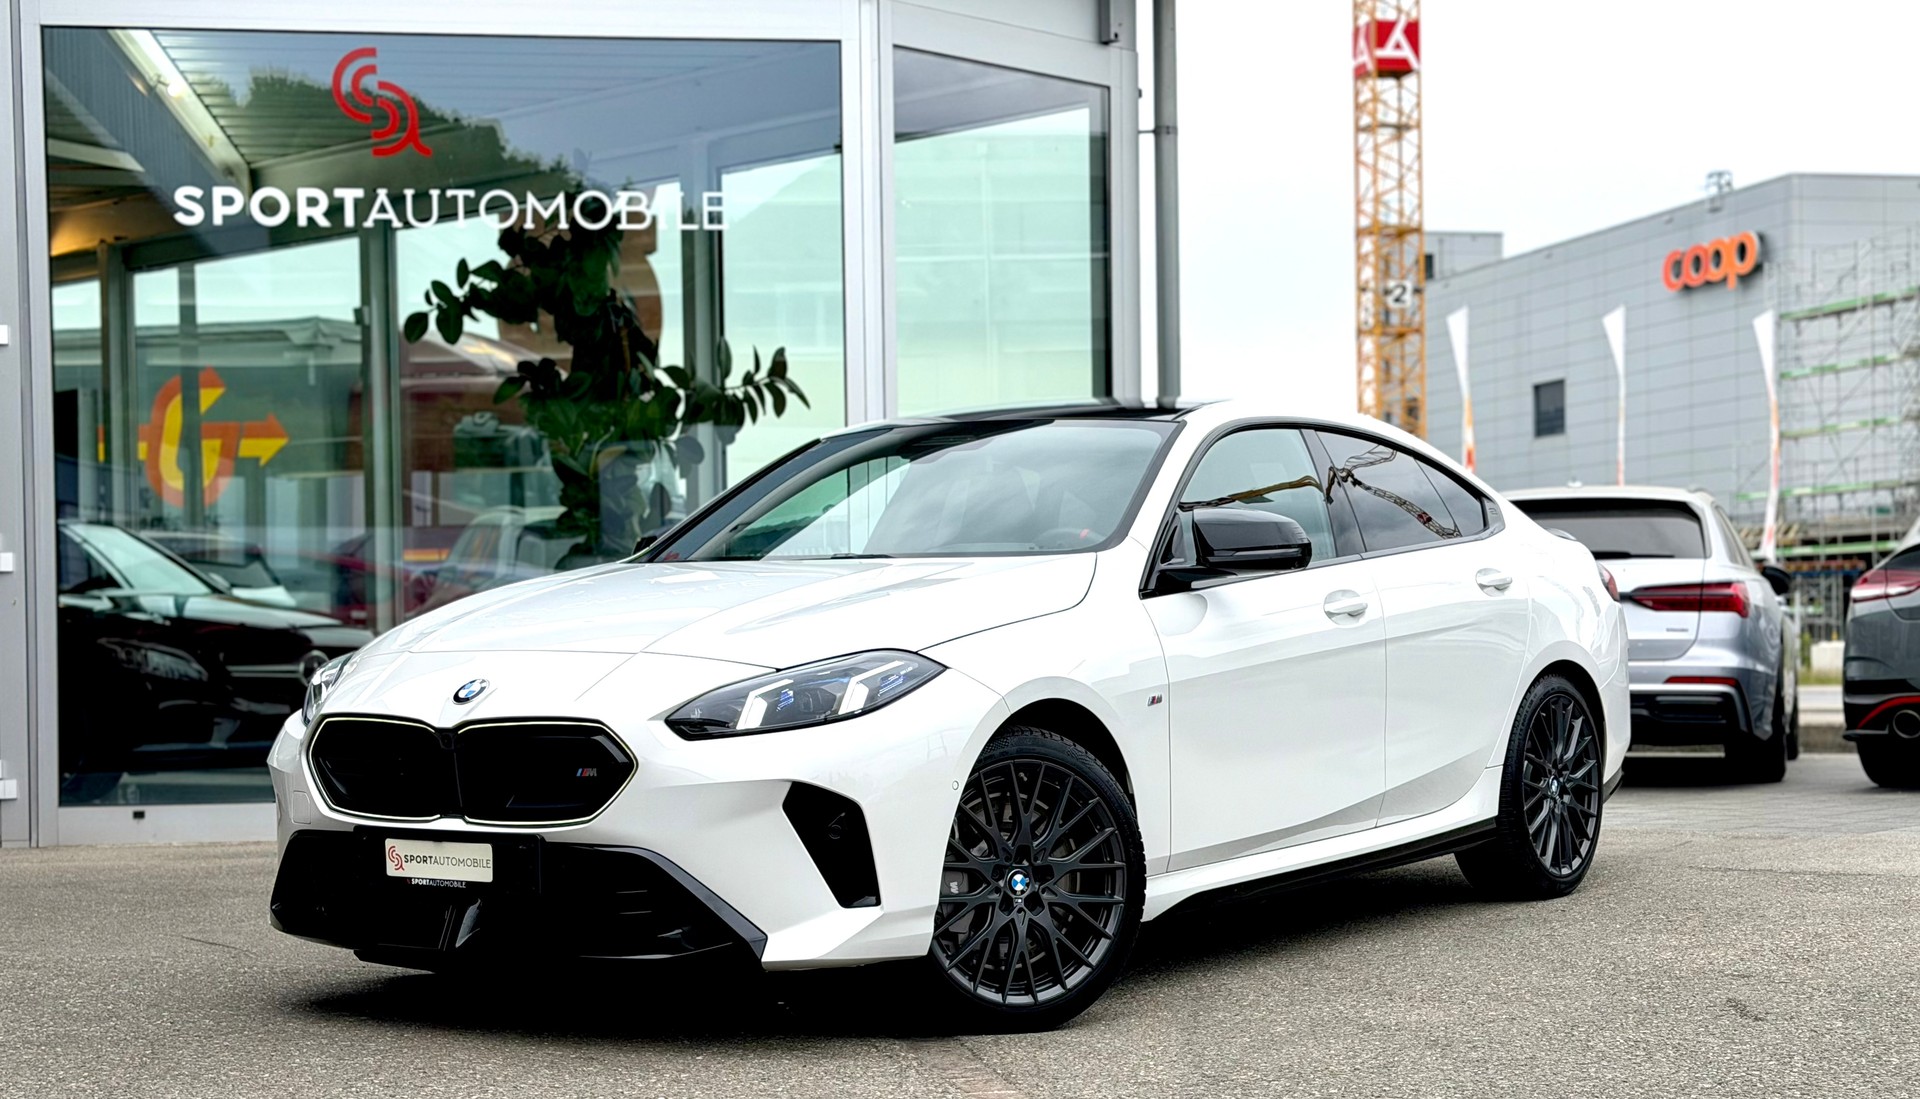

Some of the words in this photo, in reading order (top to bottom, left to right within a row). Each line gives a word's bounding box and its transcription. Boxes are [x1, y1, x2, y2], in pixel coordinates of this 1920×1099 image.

[173, 185, 729, 231] SPORTAUTOMOBILE
[1662, 231, 1758, 291] coop
[1392, 284, 1407, 303] 2
[404, 854, 492, 868] SPORTAUTOMOBILE
[411, 878, 466, 888] SPORTAUTOMOBILE
